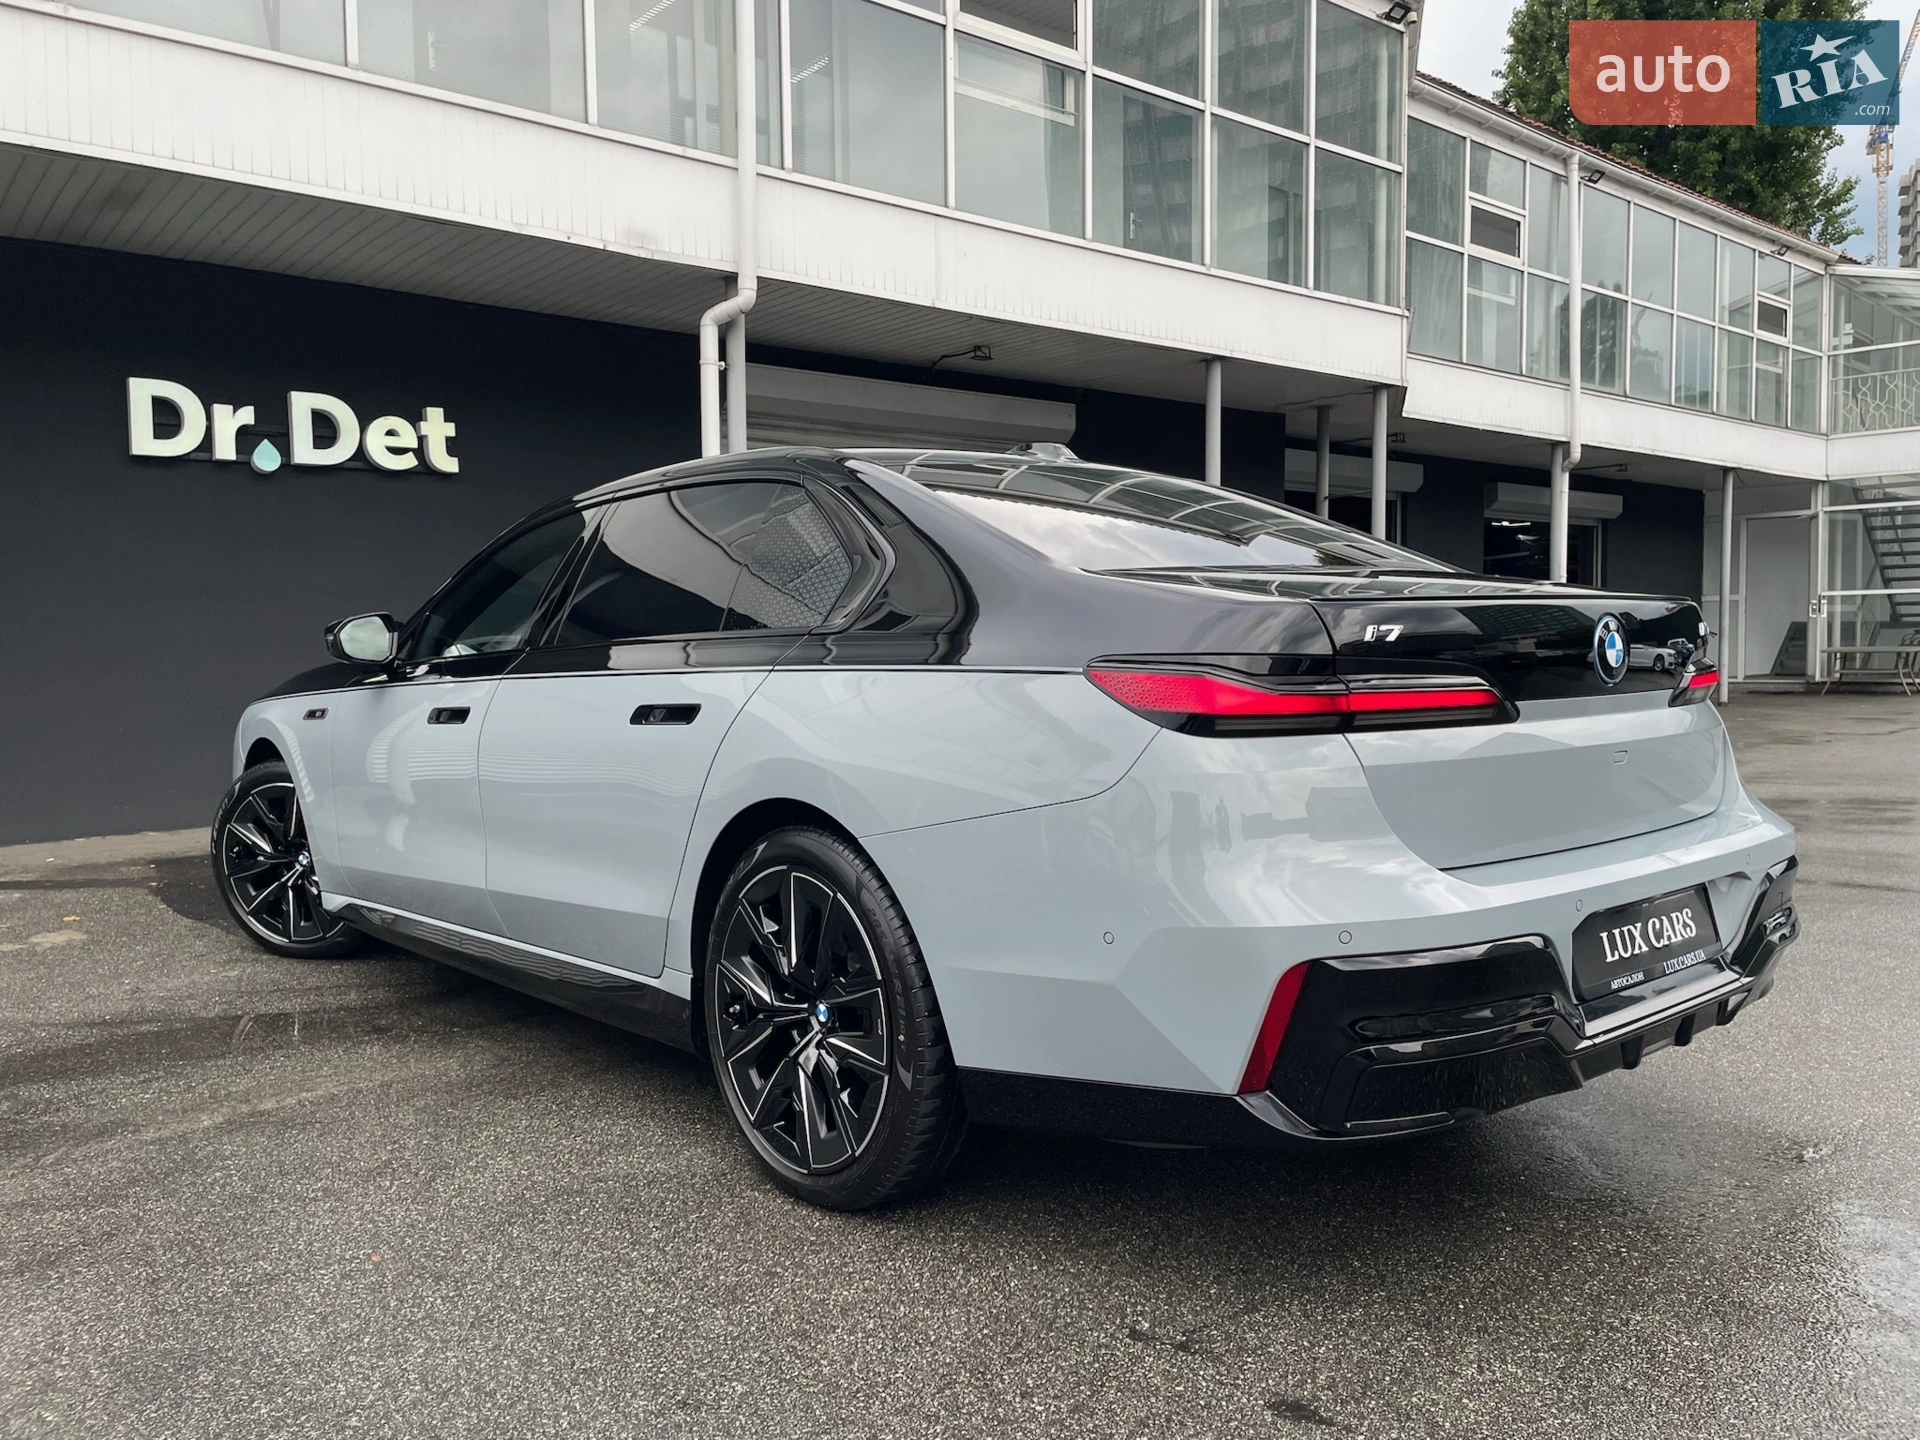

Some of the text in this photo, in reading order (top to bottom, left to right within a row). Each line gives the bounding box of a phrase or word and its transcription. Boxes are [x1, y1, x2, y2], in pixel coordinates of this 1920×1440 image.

[1363, 624, 1405, 642] i7
[1600, 908, 1697, 962] LUX CARS
